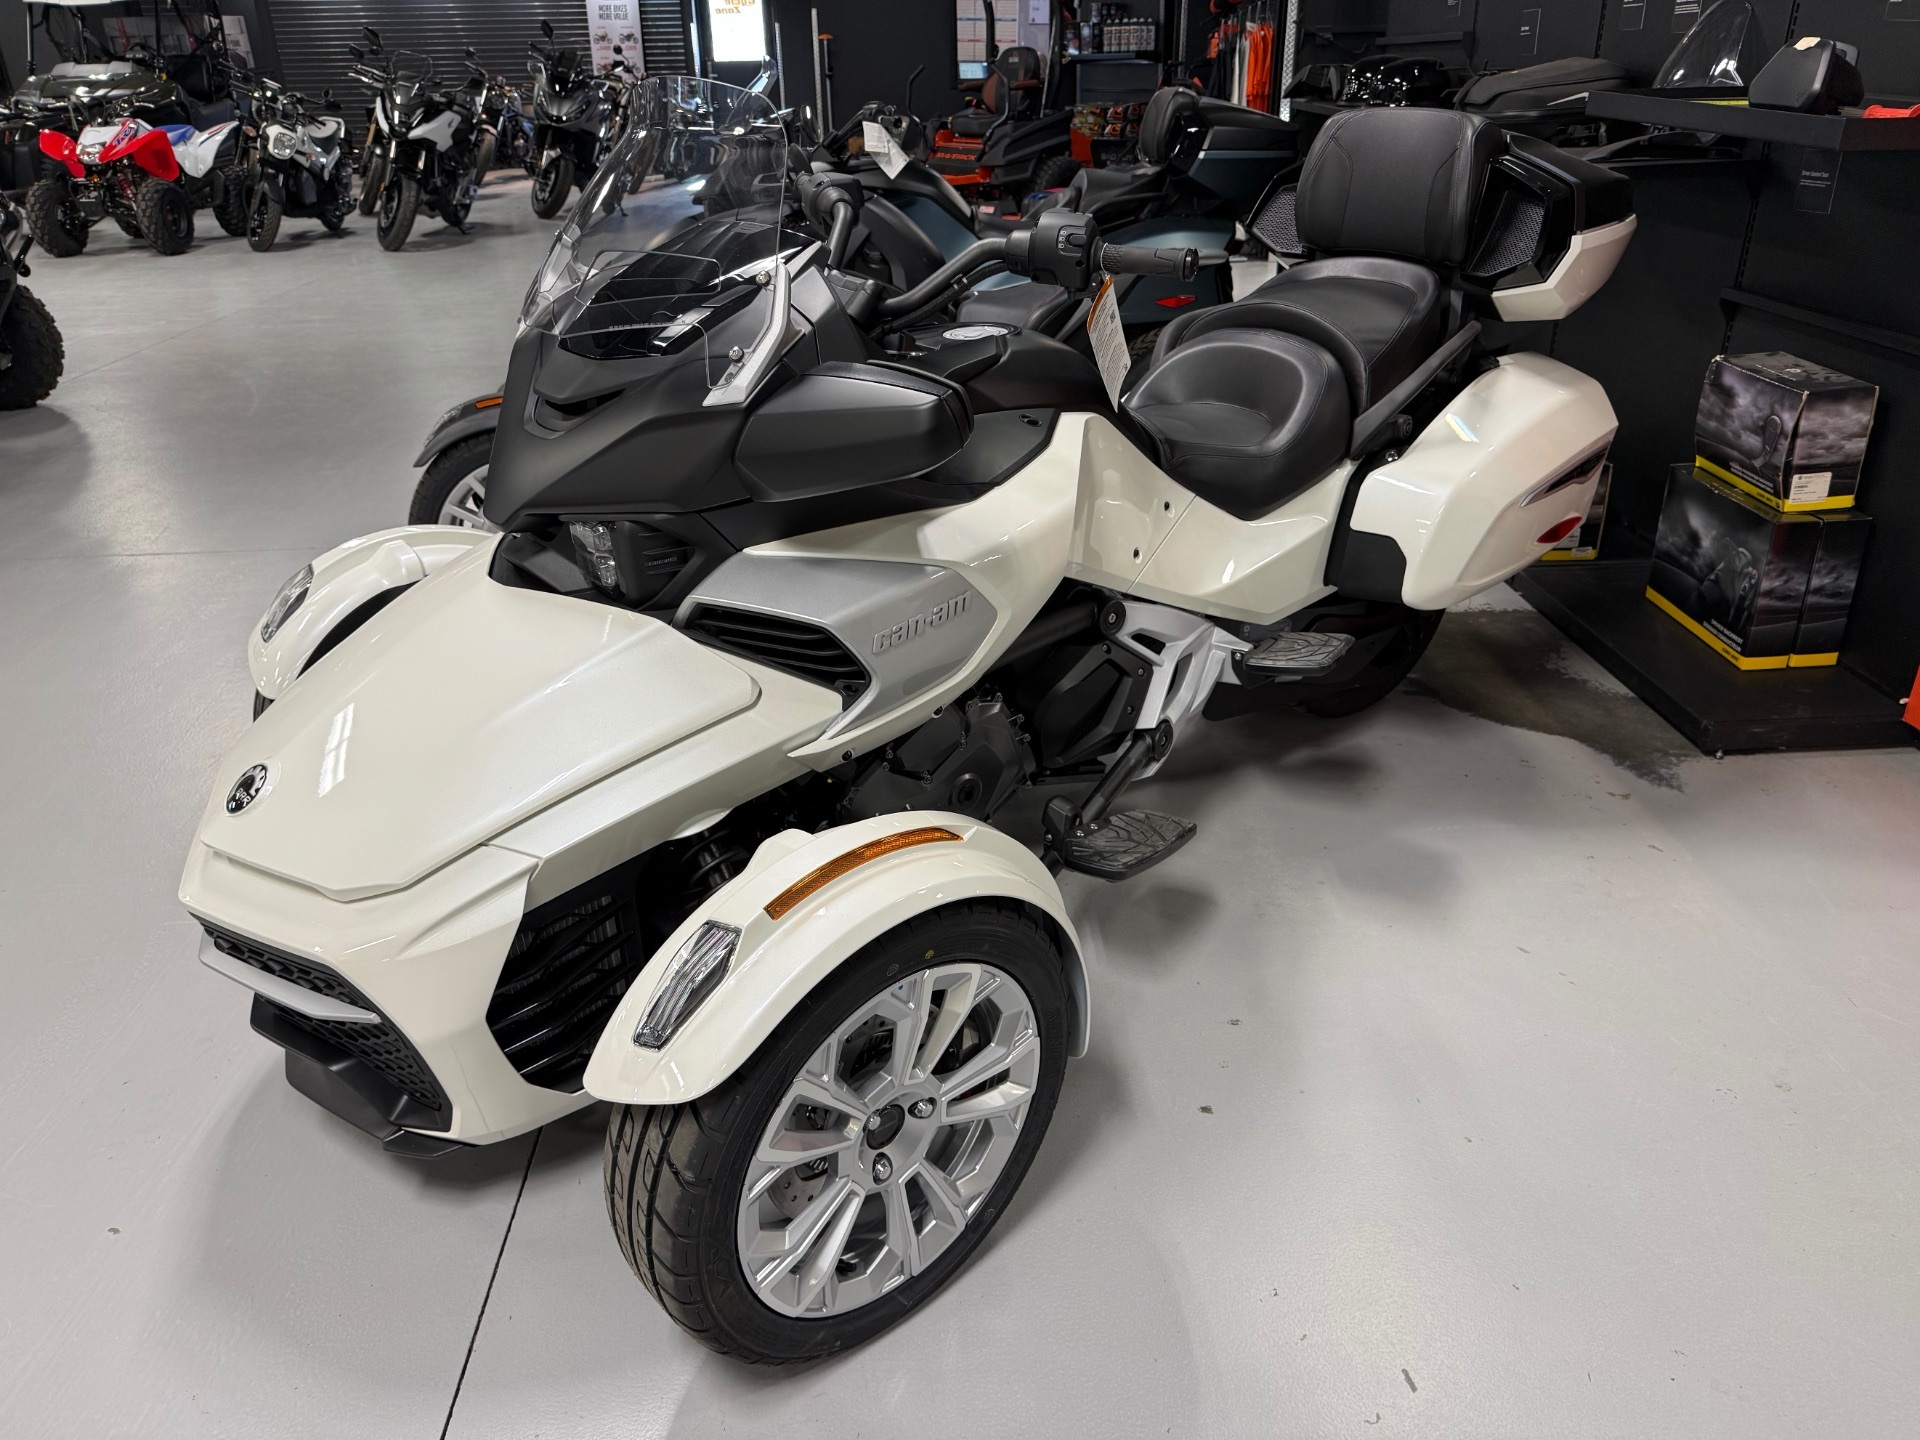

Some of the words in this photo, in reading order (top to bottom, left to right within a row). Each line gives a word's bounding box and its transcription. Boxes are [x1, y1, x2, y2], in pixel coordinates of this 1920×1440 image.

[598, 5, 612, 13] MORE
[613, 5, 627, 13] BIKES
[599, 12, 612, 20] MORE
[613, 12, 629, 20] VALUE
